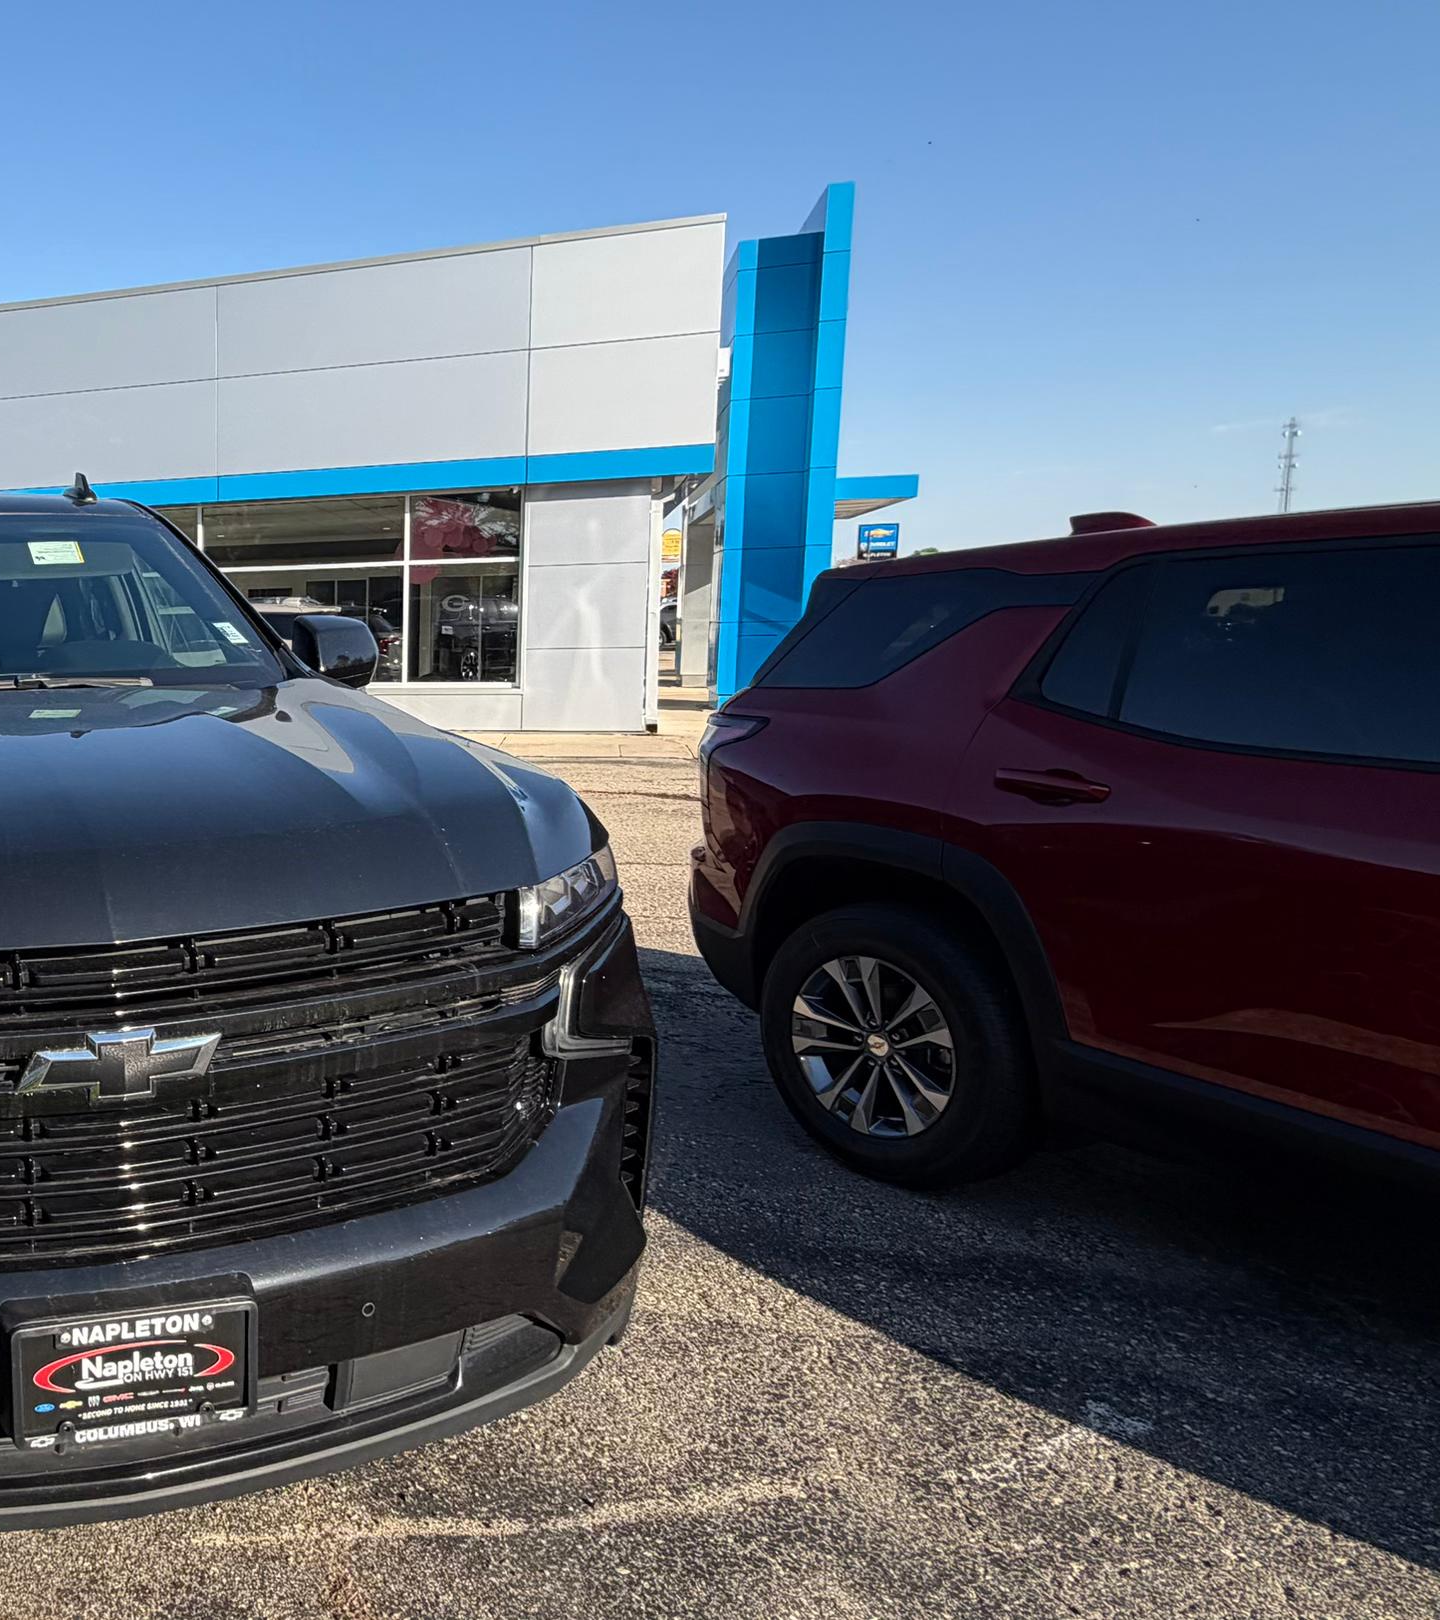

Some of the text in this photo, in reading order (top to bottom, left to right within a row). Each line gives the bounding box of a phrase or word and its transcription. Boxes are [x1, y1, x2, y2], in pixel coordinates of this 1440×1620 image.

[72, 1313, 199, 1345] NAPLETON
[81, 1350, 193, 1382] Napleton
[123, 1366, 194, 1383] ON HWY 151
[114, 1405, 124, 1415] TO
[147, 1399, 169, 1411] SINCE
[179, 1414, 201, 1428] WI
